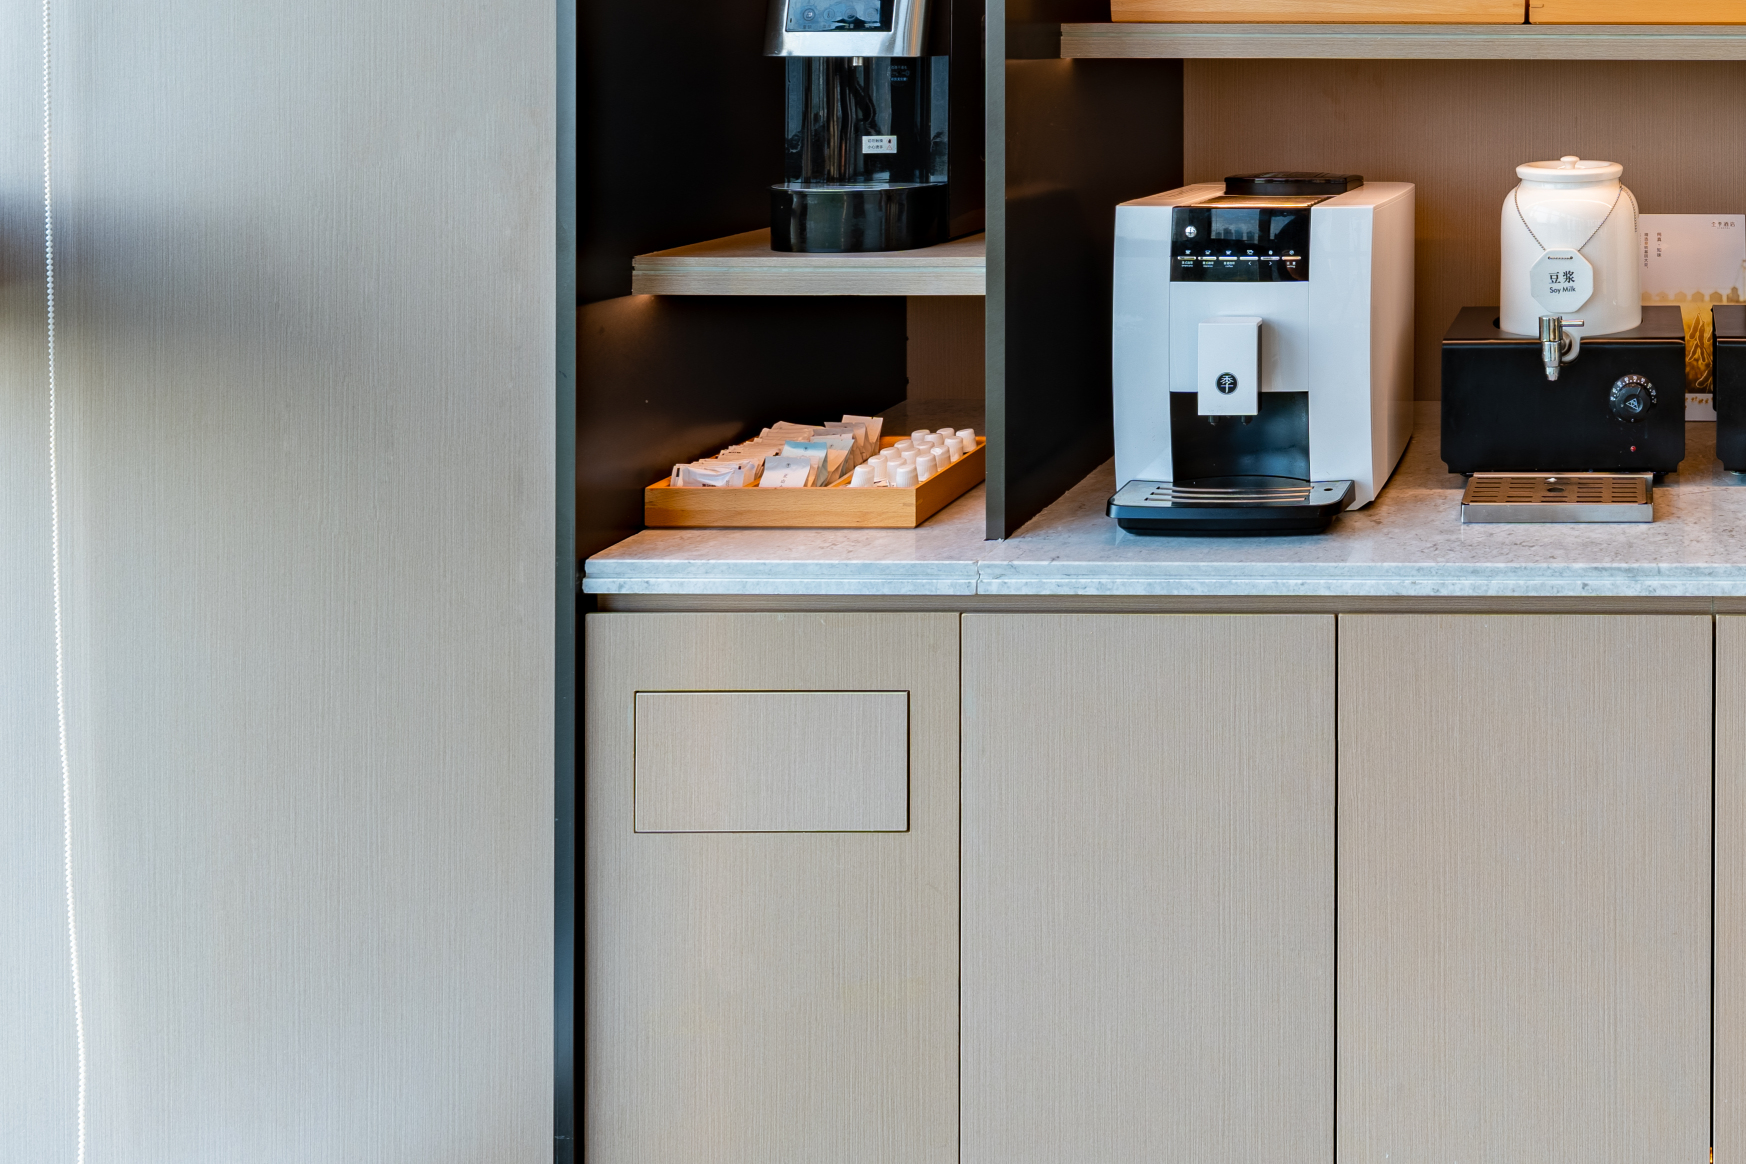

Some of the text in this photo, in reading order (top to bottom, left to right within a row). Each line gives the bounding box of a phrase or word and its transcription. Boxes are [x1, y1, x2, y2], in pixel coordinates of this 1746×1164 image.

[1548, 270, 1575, 284] 豆浆
[1549, 285, 1576, 294] Soy Milk
